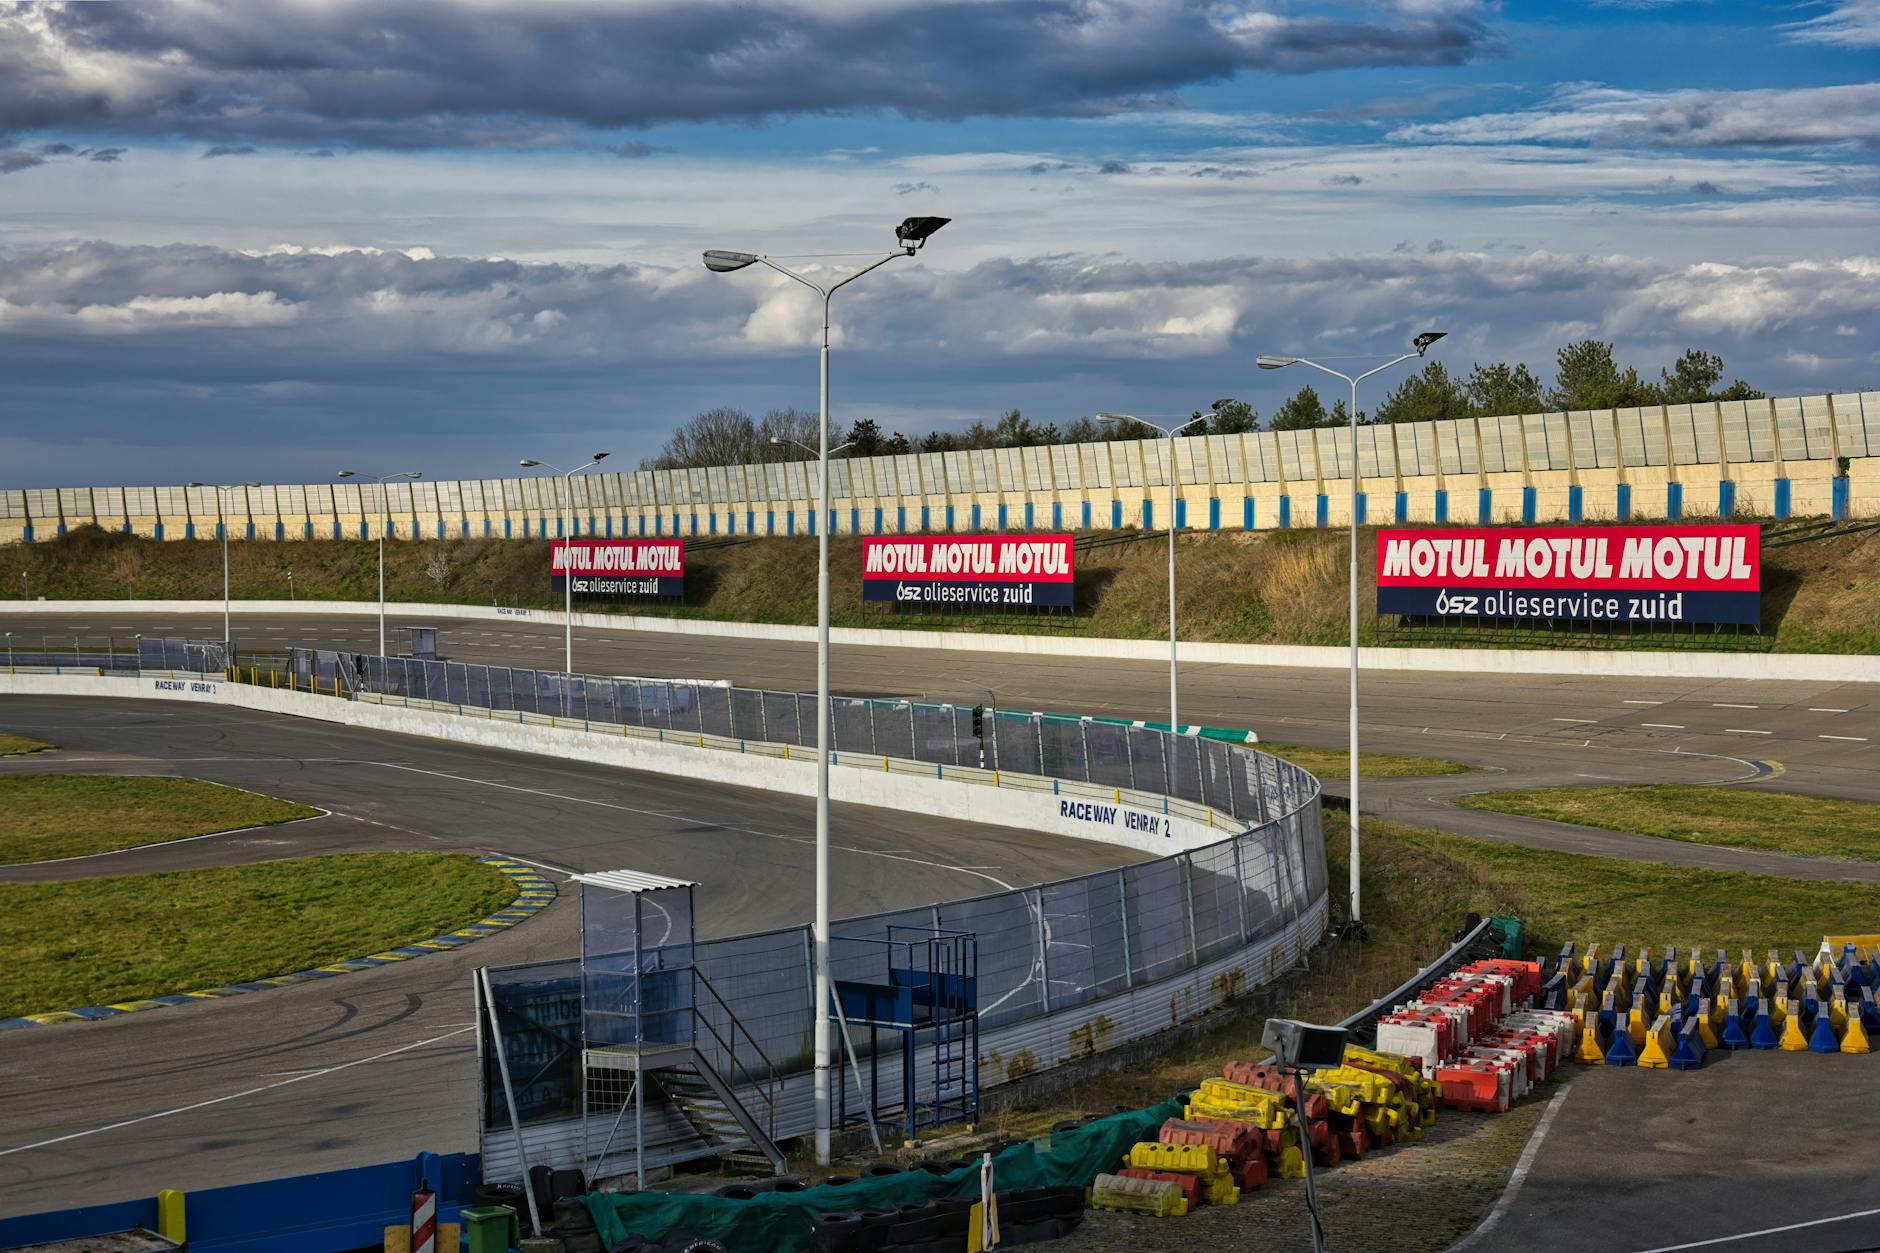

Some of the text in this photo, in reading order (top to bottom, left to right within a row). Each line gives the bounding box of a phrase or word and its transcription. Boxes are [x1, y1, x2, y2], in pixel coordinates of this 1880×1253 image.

[553, 545, 681, 571] MOTUL MOTUL MOTUL
[866, 542, 1069, 574] MOTUL MOTUL MOTUL
[1382, 536, 1752, 580] MOTUL MOTUL MOTUL
[589, 577, 637, 593] olieservice
[639, 577, 659, 594] zuid
[924, 582, 999, 602] olieservice
[1003, 583, 1033, 604] zuid
[1485, 591, 1619, 619] olieservice
[1628, 593, 1683, 620] zuid
[190, 682, 211, 694] VENRAY
[1060, 800, 1171, 838] RACEWAY VENRAY 2
